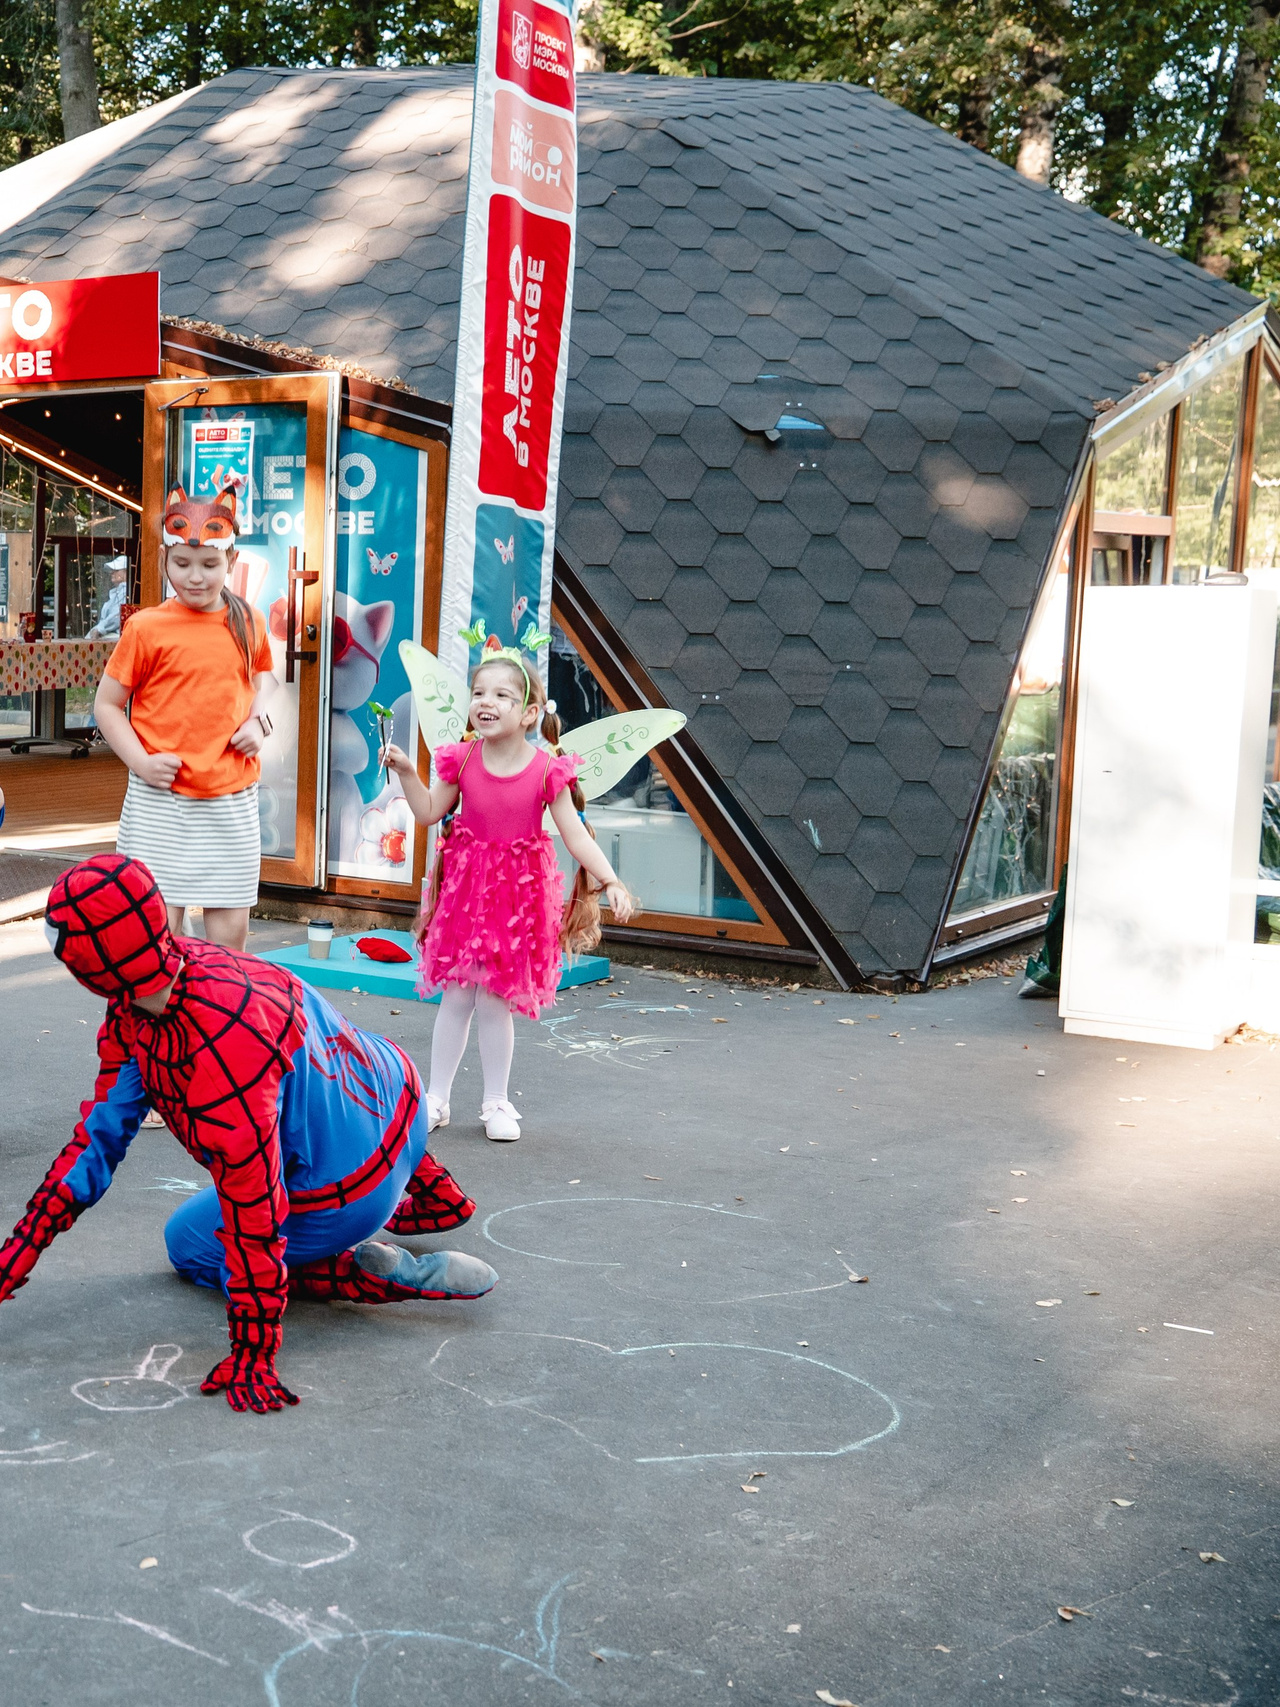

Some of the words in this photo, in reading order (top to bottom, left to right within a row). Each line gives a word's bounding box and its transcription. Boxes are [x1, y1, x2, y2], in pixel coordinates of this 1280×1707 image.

[533, 43, 558, 62] МЭРА
[534, 30, 567, 53] ПРОЕКТ
[532, 55, 570, 80] МОСКВЫ
[502, 243, 523, 460] ЛЕТО
[518, 255, 546, 429] МОСКВЕ
[517, 440, 530, 468] В
